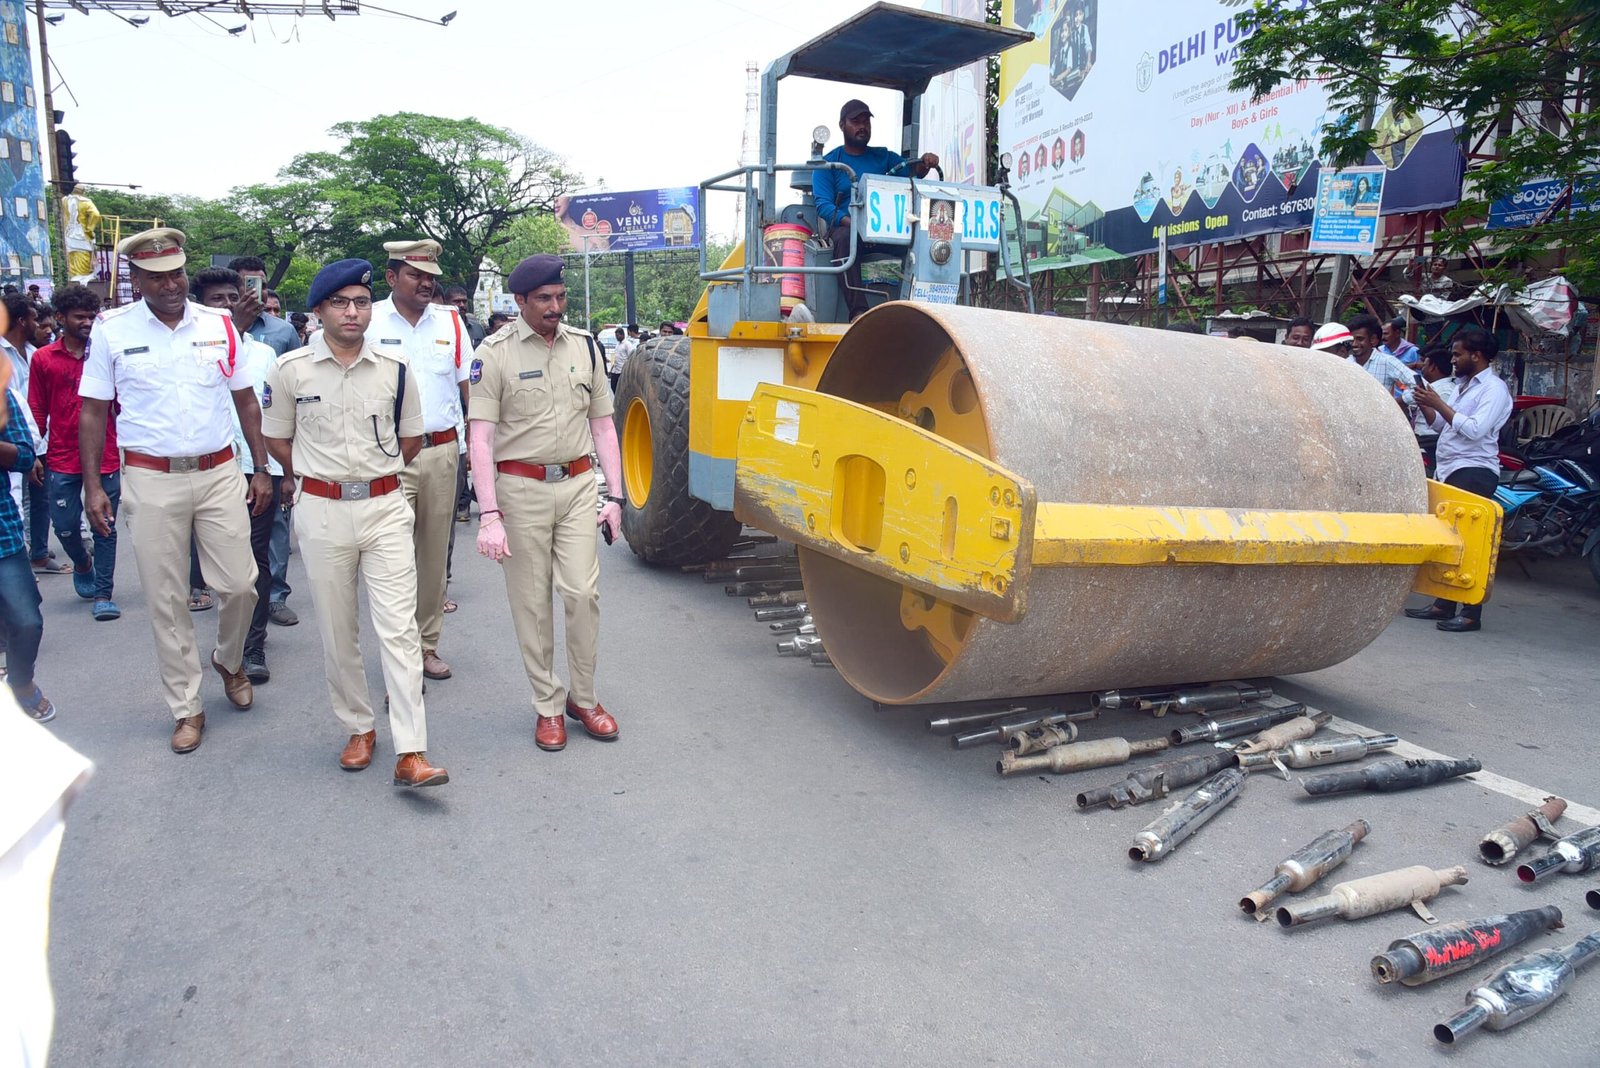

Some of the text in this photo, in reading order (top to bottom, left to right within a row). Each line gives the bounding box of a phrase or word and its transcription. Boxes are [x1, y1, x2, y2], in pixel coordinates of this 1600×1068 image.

[1158, 30, 1206, 75] DELHI
[1190, 116, 1204, 128] Day
[1205, 110, 1220, 125] (Nur
[1226, 103, 1239, 117] XII)
[1241, 100, 1247, 111] &
[1232, 106, 1279, 130] Boys & Girls
[616, 215, 658, 227] VENUS
[1242, 205, 1278, 223] Contact:
[1279, 196, 1317, 216] 967630
[1152, 214, 1229, 239] Aissions Open
